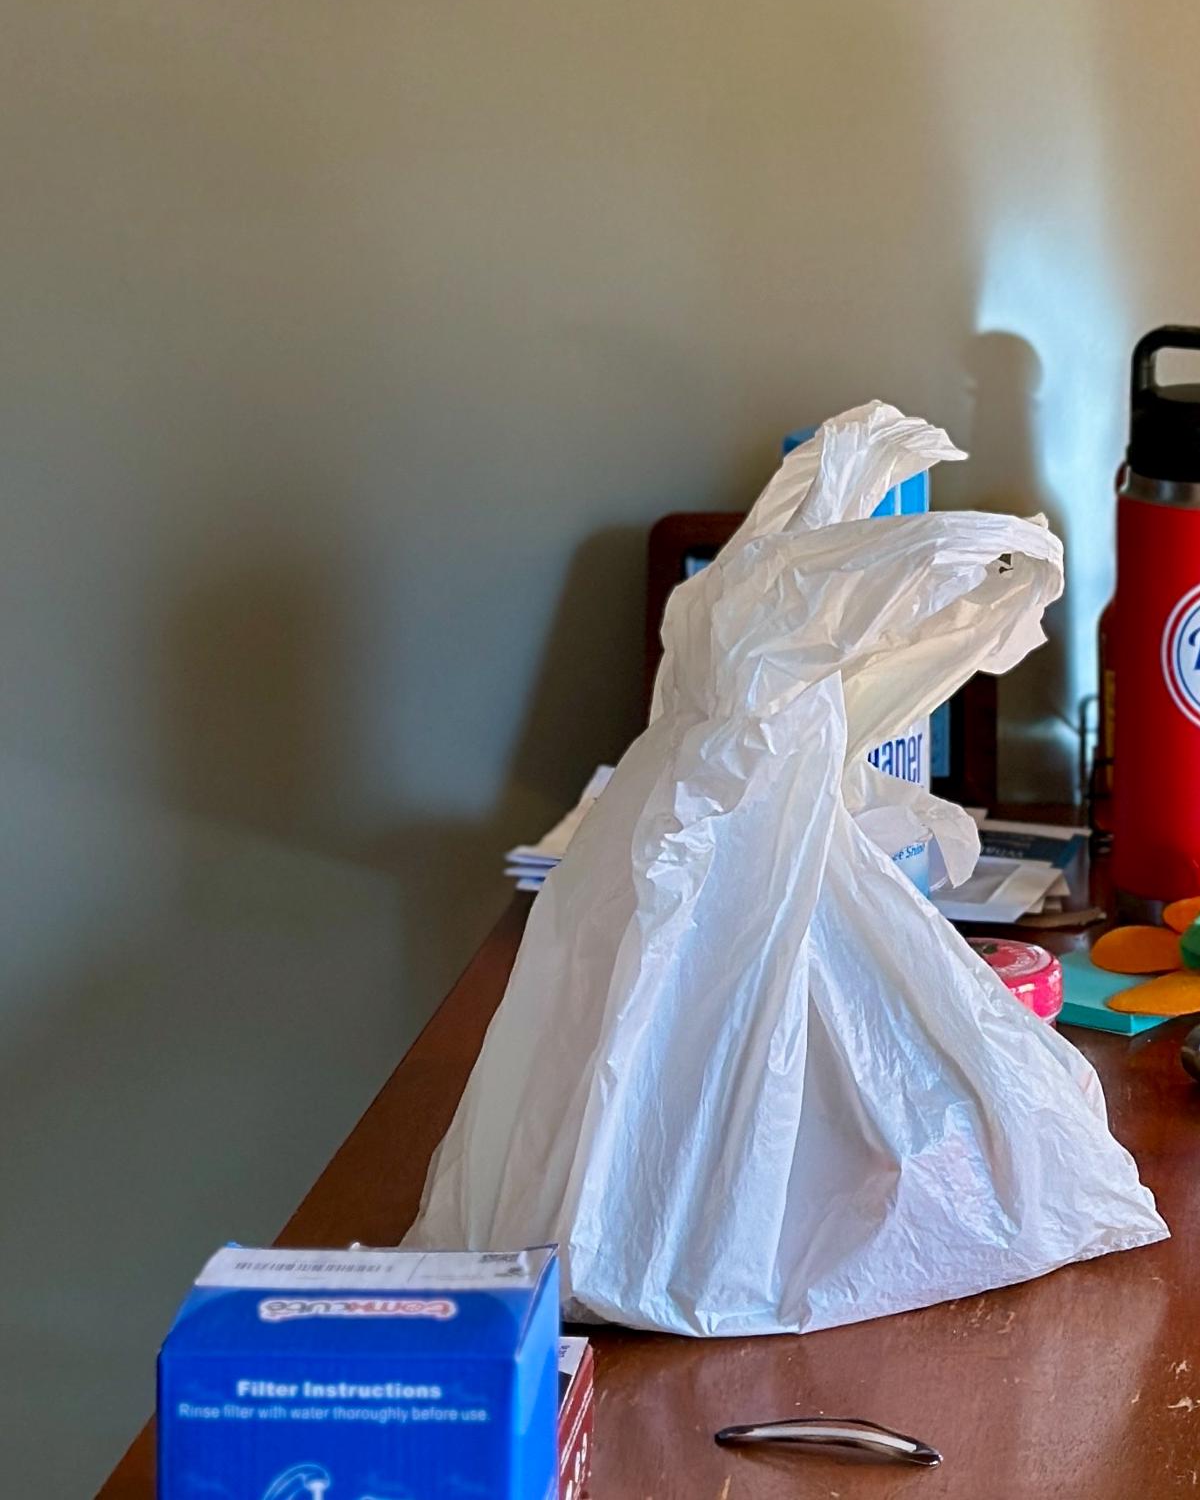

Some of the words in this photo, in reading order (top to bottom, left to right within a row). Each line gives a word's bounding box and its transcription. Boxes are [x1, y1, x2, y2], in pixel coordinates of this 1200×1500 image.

[236, 1380, 299, 1398] Filter
[303, 1381, 442, 1399] Instructions
[178, 1403, 220, 1419] Rinse
[223, 1404, 254, 1419] filter
[258, 1405, 287, 1419] with
[290, 1406, 329, 1420] water
[333, 1405, 408, 1424] thoroughly
[412, 1407, 457, 1421] before
